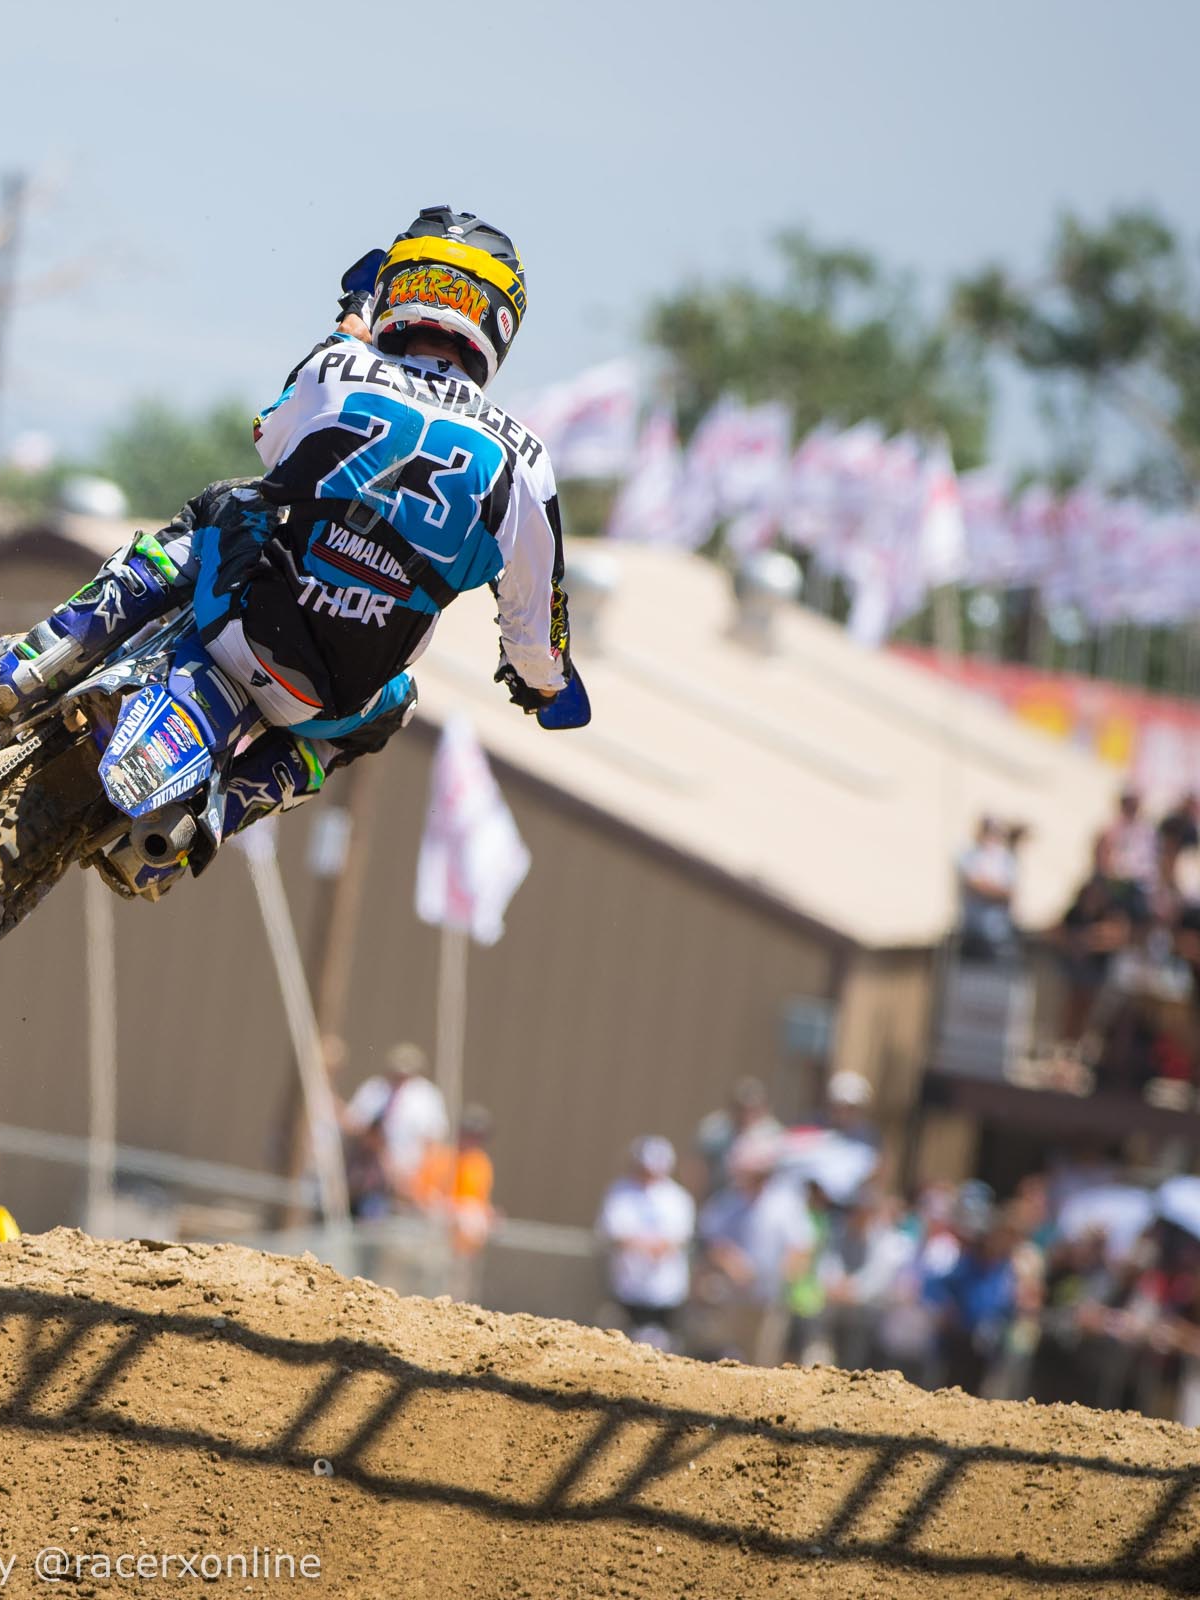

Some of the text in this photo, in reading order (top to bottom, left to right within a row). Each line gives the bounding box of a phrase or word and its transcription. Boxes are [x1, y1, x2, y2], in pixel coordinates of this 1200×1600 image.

[388, 266, 490, 327] AARON
[500, 311, 511, 337] BELL
[314, 391, 506, 564] 23
[297, 576, 396, 628] THOR
[110, 699, 150, 756] DUNLOP
[150, 770, 198, 810] DUNLOP
